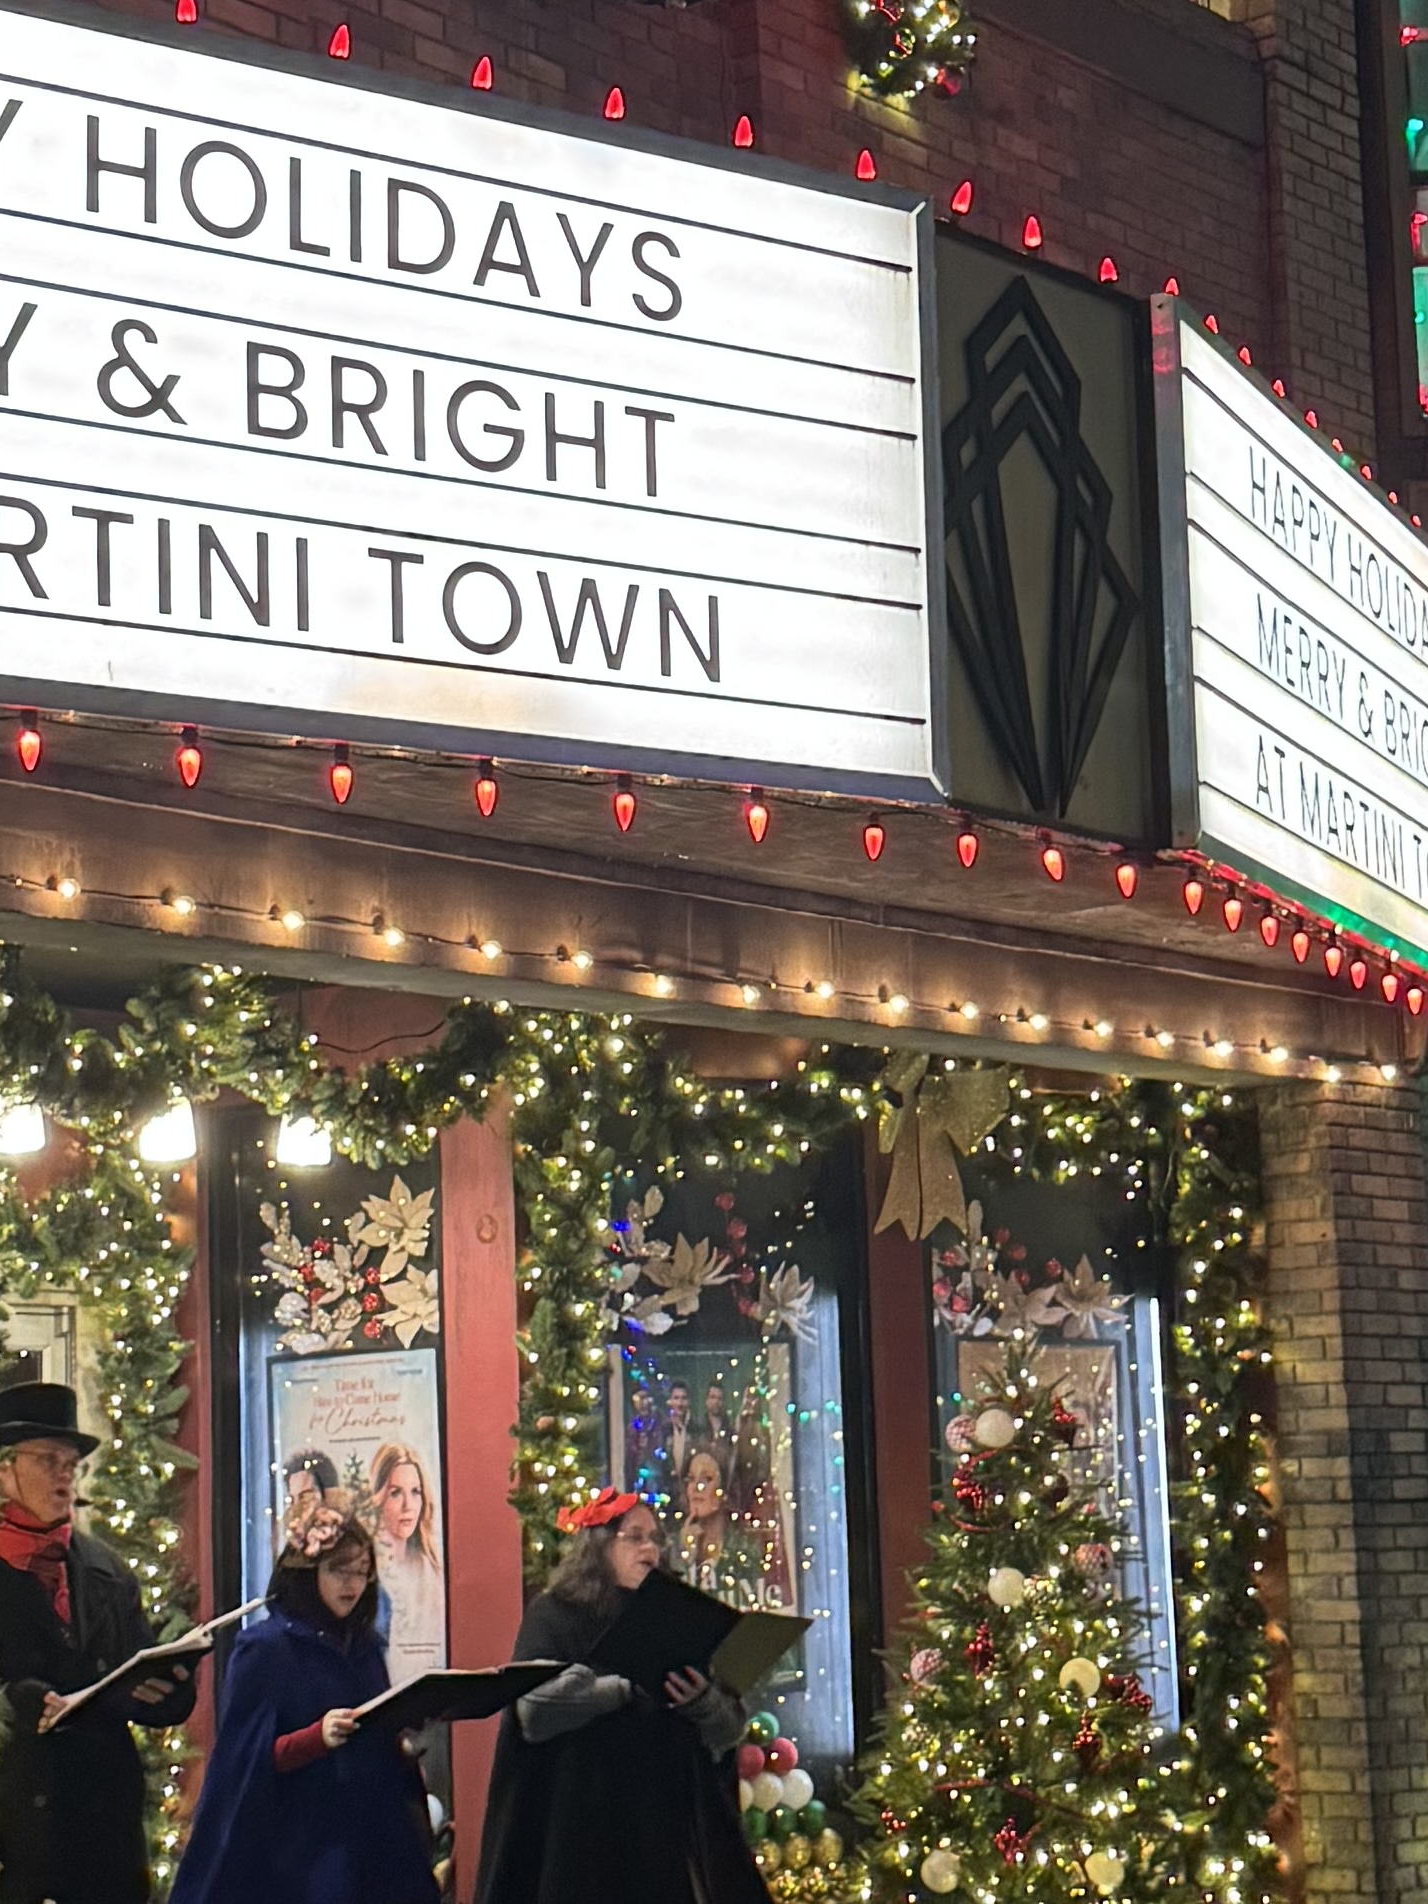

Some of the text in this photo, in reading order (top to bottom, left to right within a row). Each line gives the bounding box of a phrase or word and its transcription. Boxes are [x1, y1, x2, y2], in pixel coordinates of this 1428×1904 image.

[86, 114, 682, 322] HOLIDAYS
[96, 318, 188, 426] &
[246, 340, 675, 498] BRIGHT
[1249, 445, 1337, 584] HAPPY
[367, 547, 721, 683] TOWN
[1257, 592, 1346, 721] MERRY
[1358, 671, 1375, 744] &
[1256, 733, 1286, 821] AT
[1299, 760, 1406, 891] MARTINI
[325, 1407, 406, 1434] Christmas
